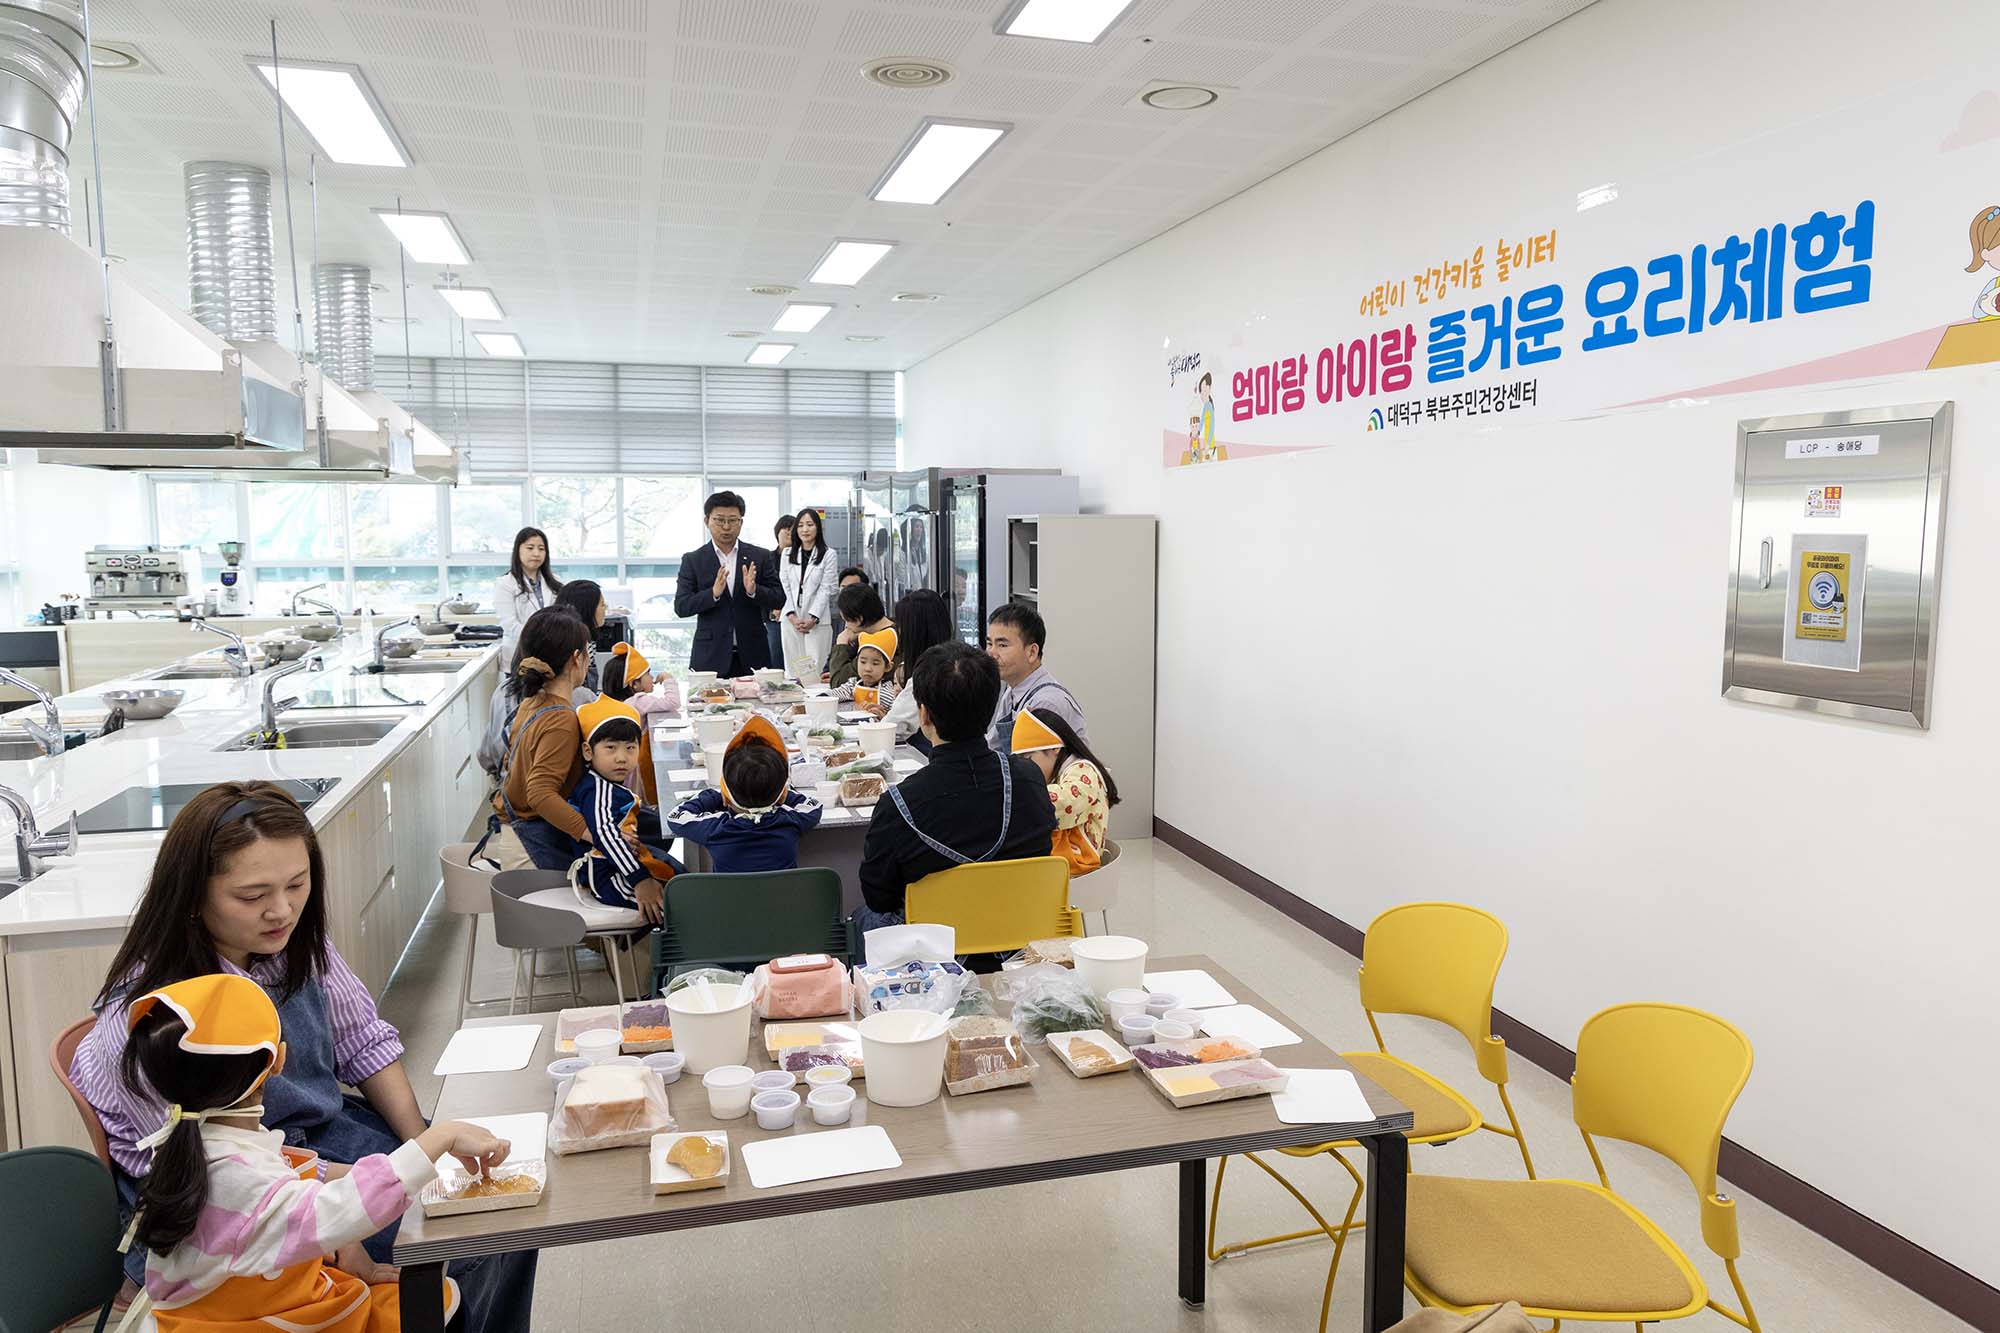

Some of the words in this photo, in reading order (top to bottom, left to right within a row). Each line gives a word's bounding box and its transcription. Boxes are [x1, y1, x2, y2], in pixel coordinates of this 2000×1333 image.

[1359, 280, 1405, 317] 어린이
[1413, 245, 1485, 304] 건강키움
[1495, 229, 1557, 282] 놀이터
[1232, 353, 1308, 422] 엄마랑
[1316, 323, 1417, 404] 아이랑
[1427, 283, 1564, 384] 즐거운
[1581, 199, 1875, 352] 요리체험
[1387, 400, 1422, 427] 대덕구
[1426, 378, 1538, 422] 북부주민건강센터
[1799, 443, 1819, 454] LCP
[1836, 440, 1863, 452] 송애당
